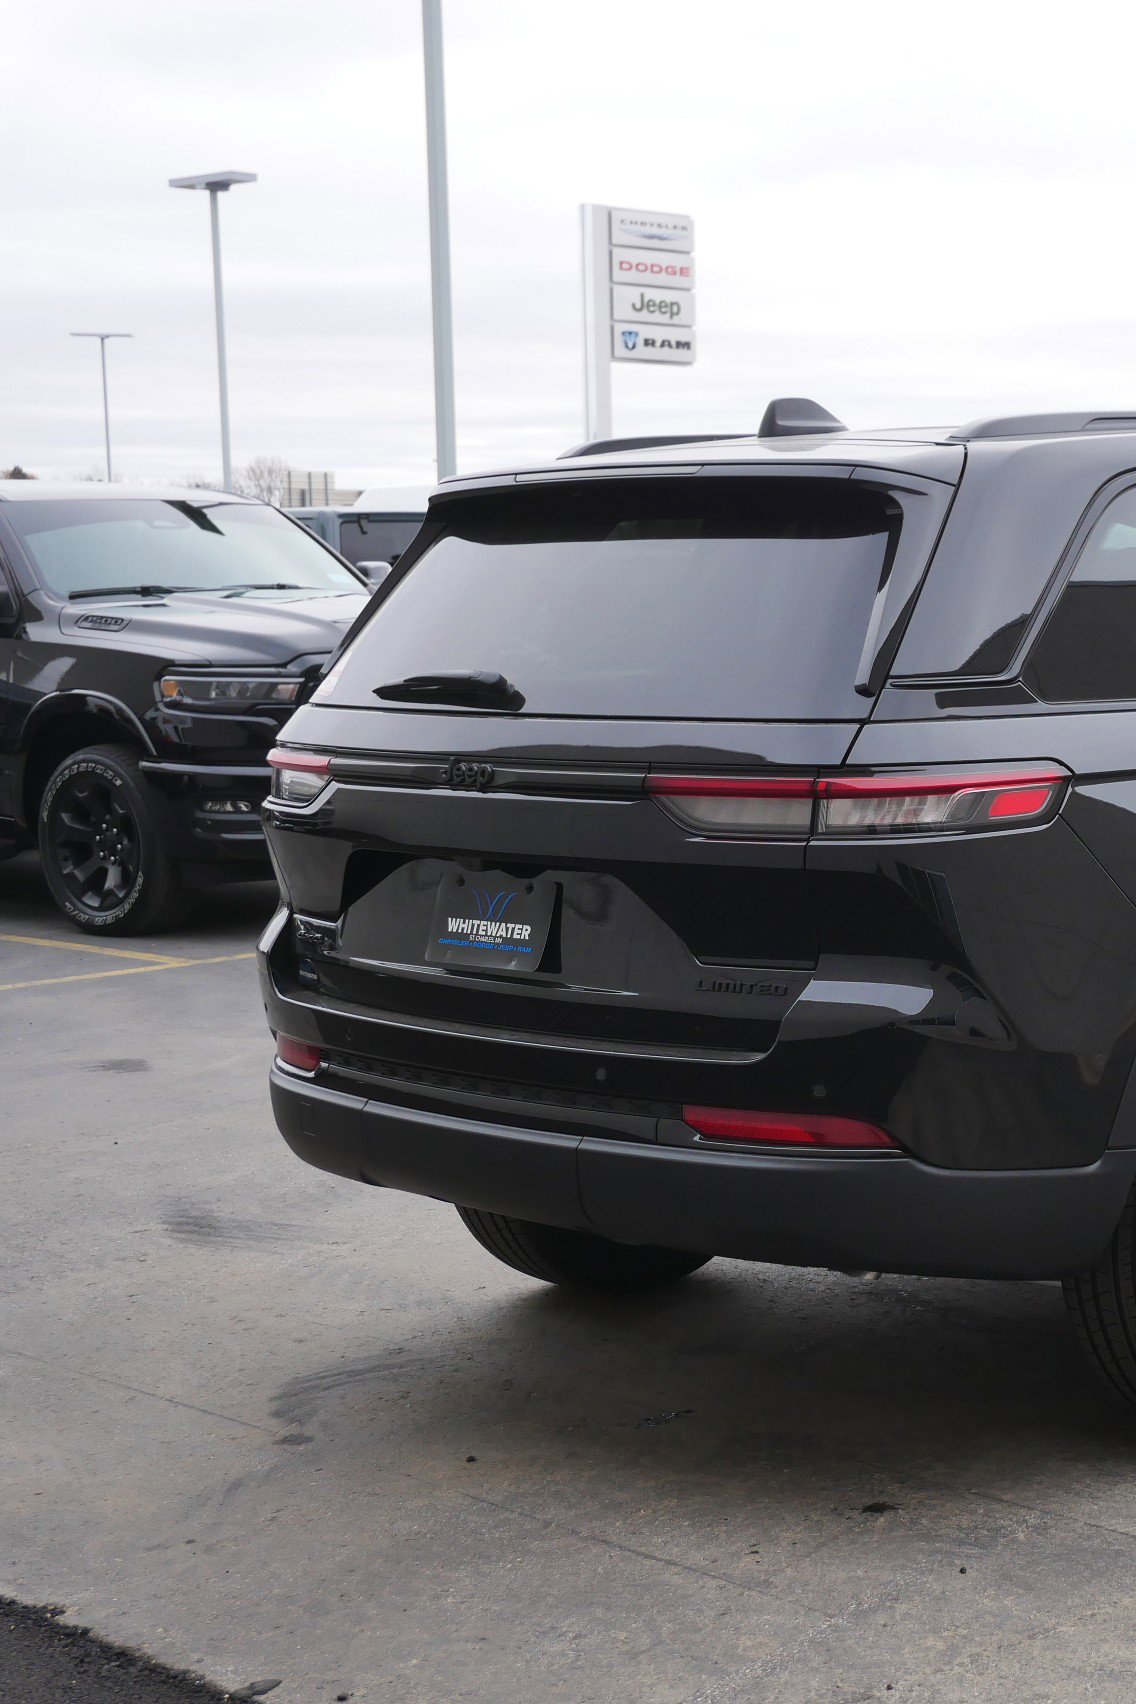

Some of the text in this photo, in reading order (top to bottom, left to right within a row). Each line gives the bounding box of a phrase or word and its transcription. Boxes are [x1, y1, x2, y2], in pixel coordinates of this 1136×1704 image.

[620, 219, 688, 231] CHRYSLER
[619, 261, 690, 277] DODGE
[632, 292, 681, 319] Jeep
[643, 338, 691, 351] RAM
[441, 757, 495, 791] Jeep
[447, 917, 531, 939] WHITEWATER
[438, 938, 469, 946] CHRYSLER
